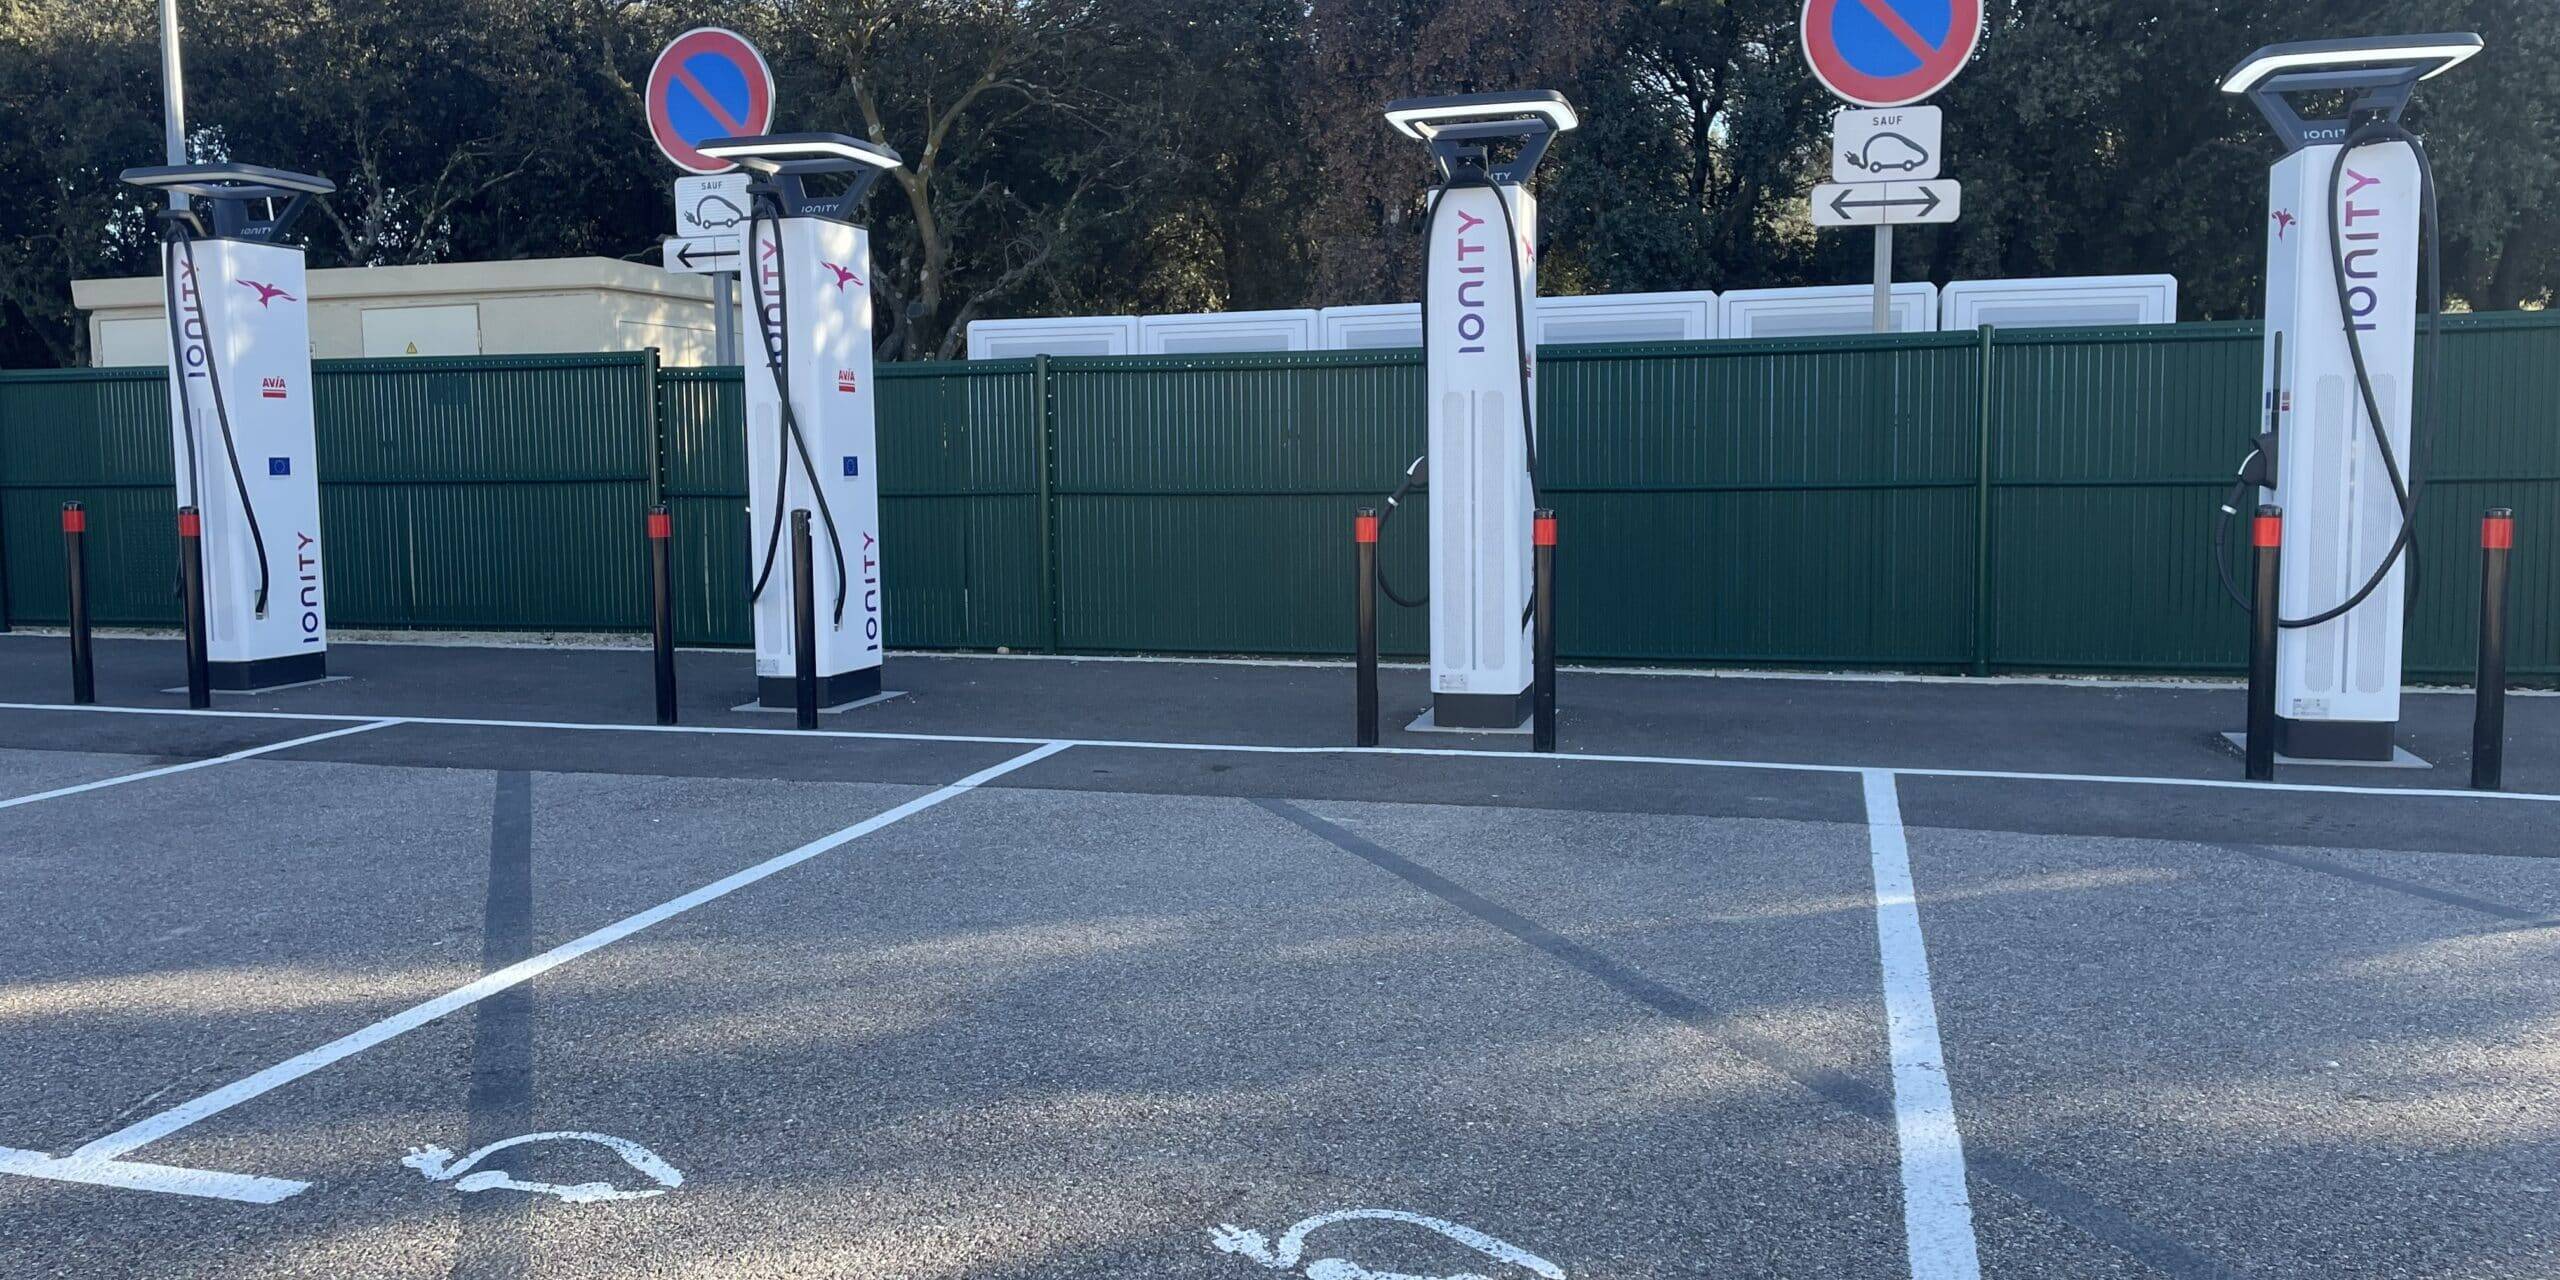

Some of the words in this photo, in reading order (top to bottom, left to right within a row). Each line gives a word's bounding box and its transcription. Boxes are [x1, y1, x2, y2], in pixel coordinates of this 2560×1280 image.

[1872, 115, 1904, 126] SAUF
[2304, 128, 2346, 139] IONIT
[701, 180, 723, 190] SAUF
[801, 203, 840, 213] IONITY
[1457, 209, 1485, 354] IONITY
[2342, 168, 2381, 331] IONITY
[181, 259, 206, 378] IONITY
[298, 531, 320, 644] IONITY
[863, 531, 878, 651] IONITY
